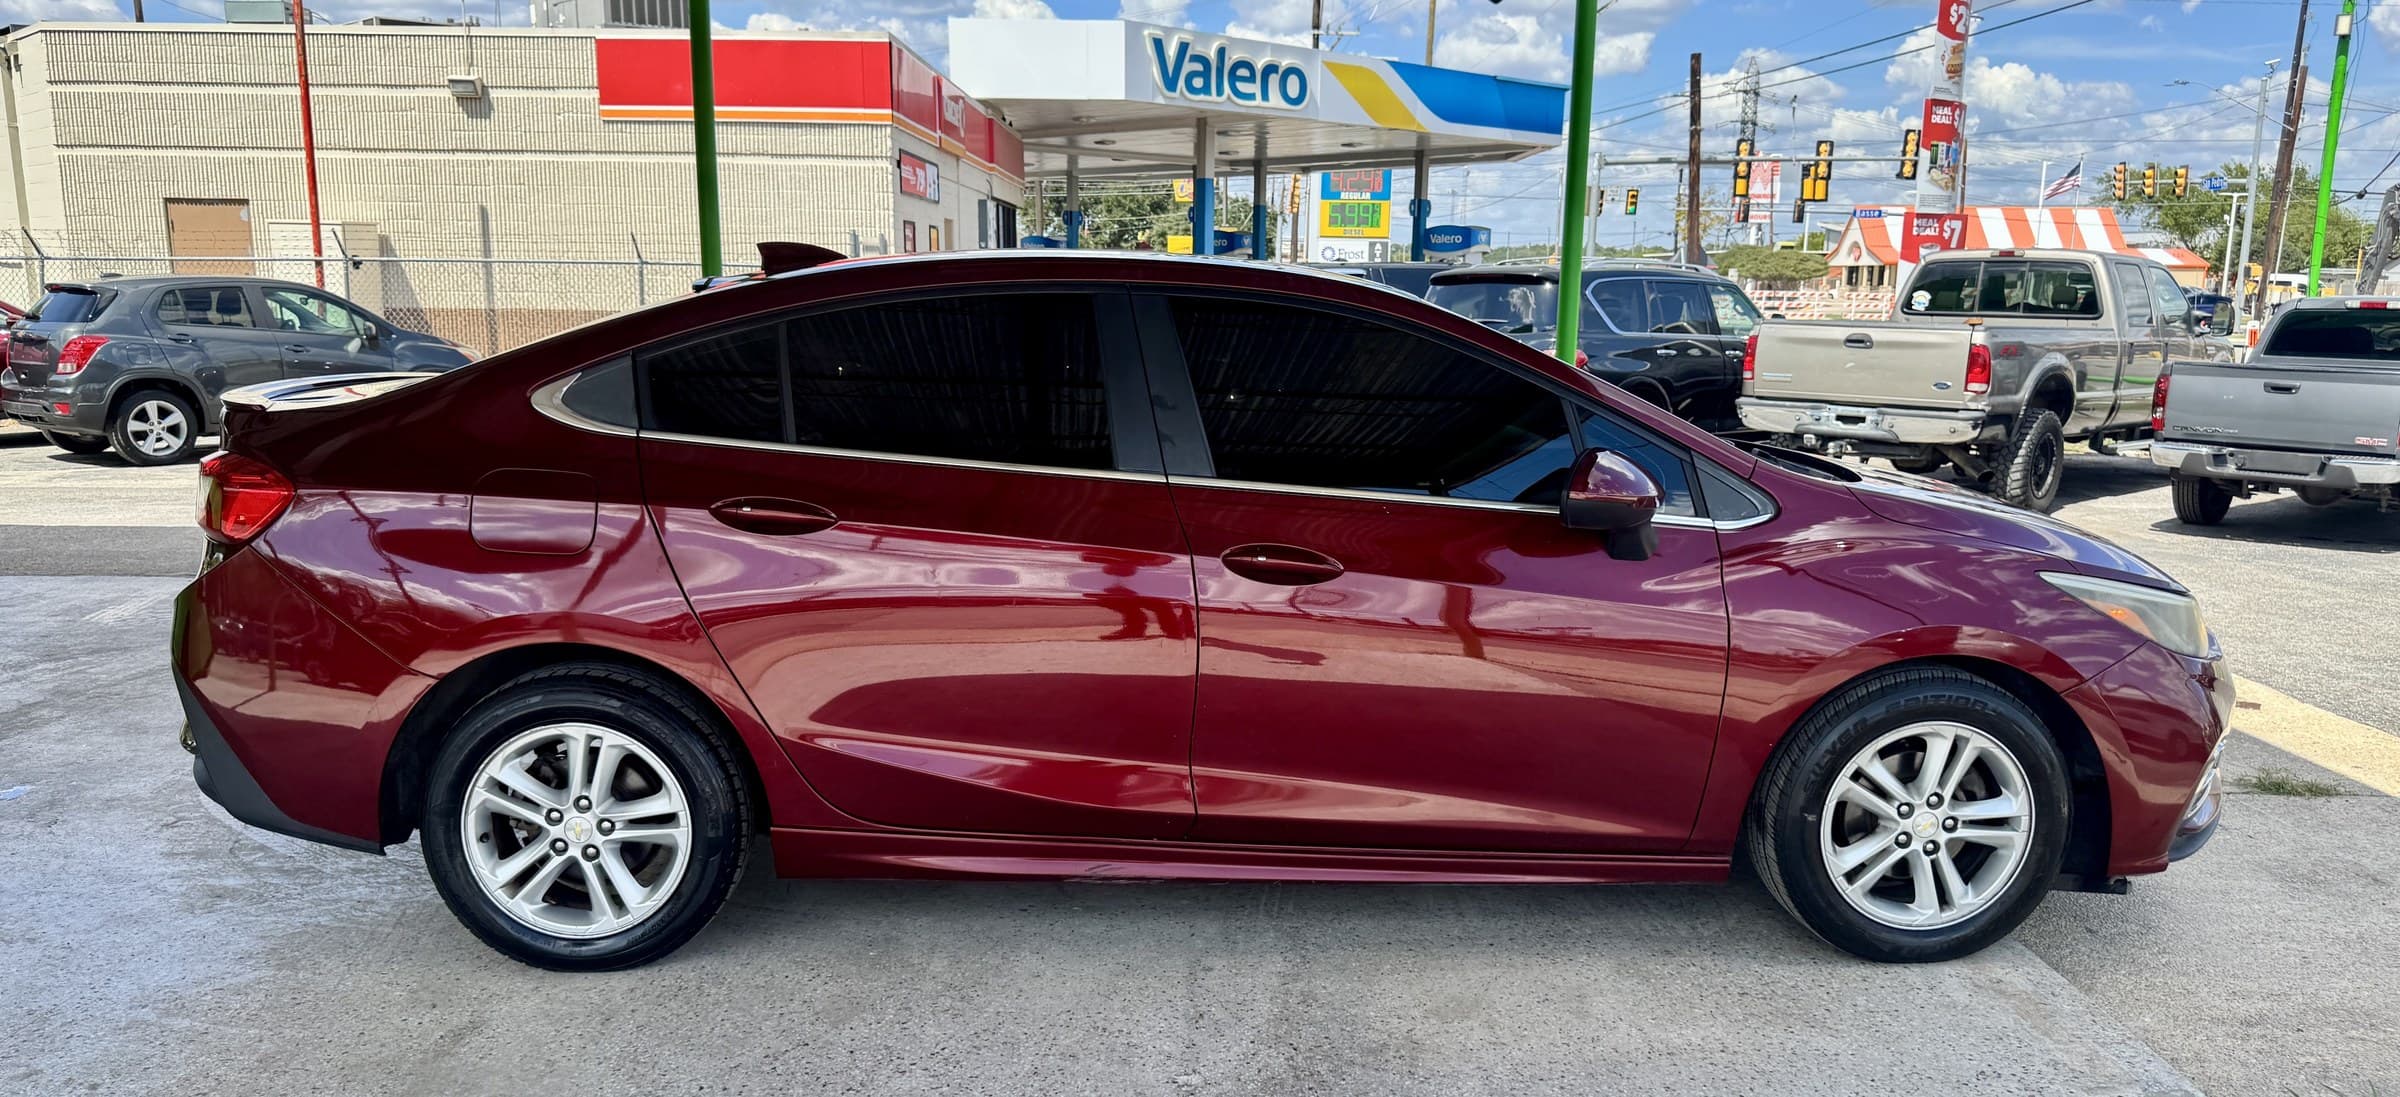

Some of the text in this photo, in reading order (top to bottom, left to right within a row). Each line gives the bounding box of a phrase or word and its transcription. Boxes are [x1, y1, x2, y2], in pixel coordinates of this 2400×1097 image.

[1151, 36, 1309, 107] Valero
[1913, 217, 1939, 227] MEAL
[1912, 226, 1939, 236] DEAL!
[1943, 219, 1962, 248] $7
[1430, 234, 1463, 243] Valero
[1339, 248, 1364, 260] Frost
